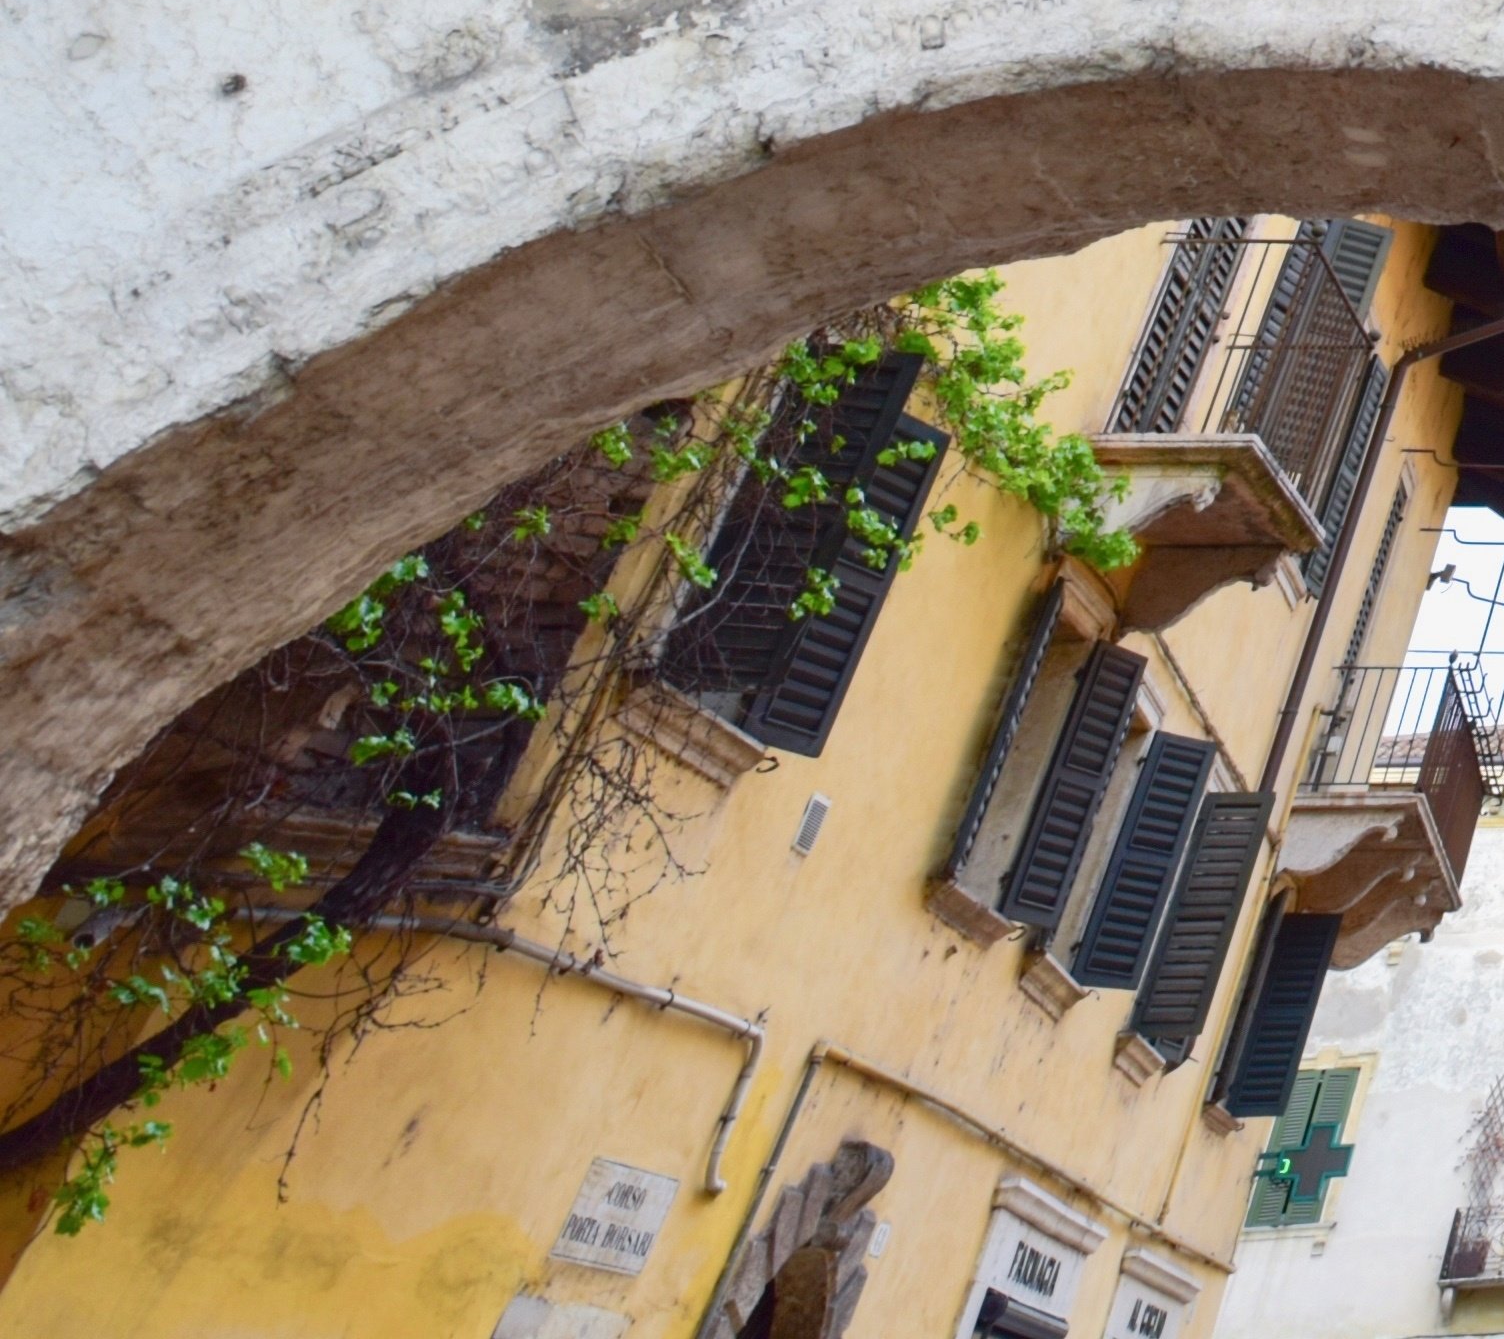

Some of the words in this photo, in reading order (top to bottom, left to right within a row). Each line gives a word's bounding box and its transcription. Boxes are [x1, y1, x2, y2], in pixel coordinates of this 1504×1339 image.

[605, 1181, 648, 1212] CORSO
[561, 1213, 602, 1246] PORTA
[600, 1223, 655, 1257] BORSARI
